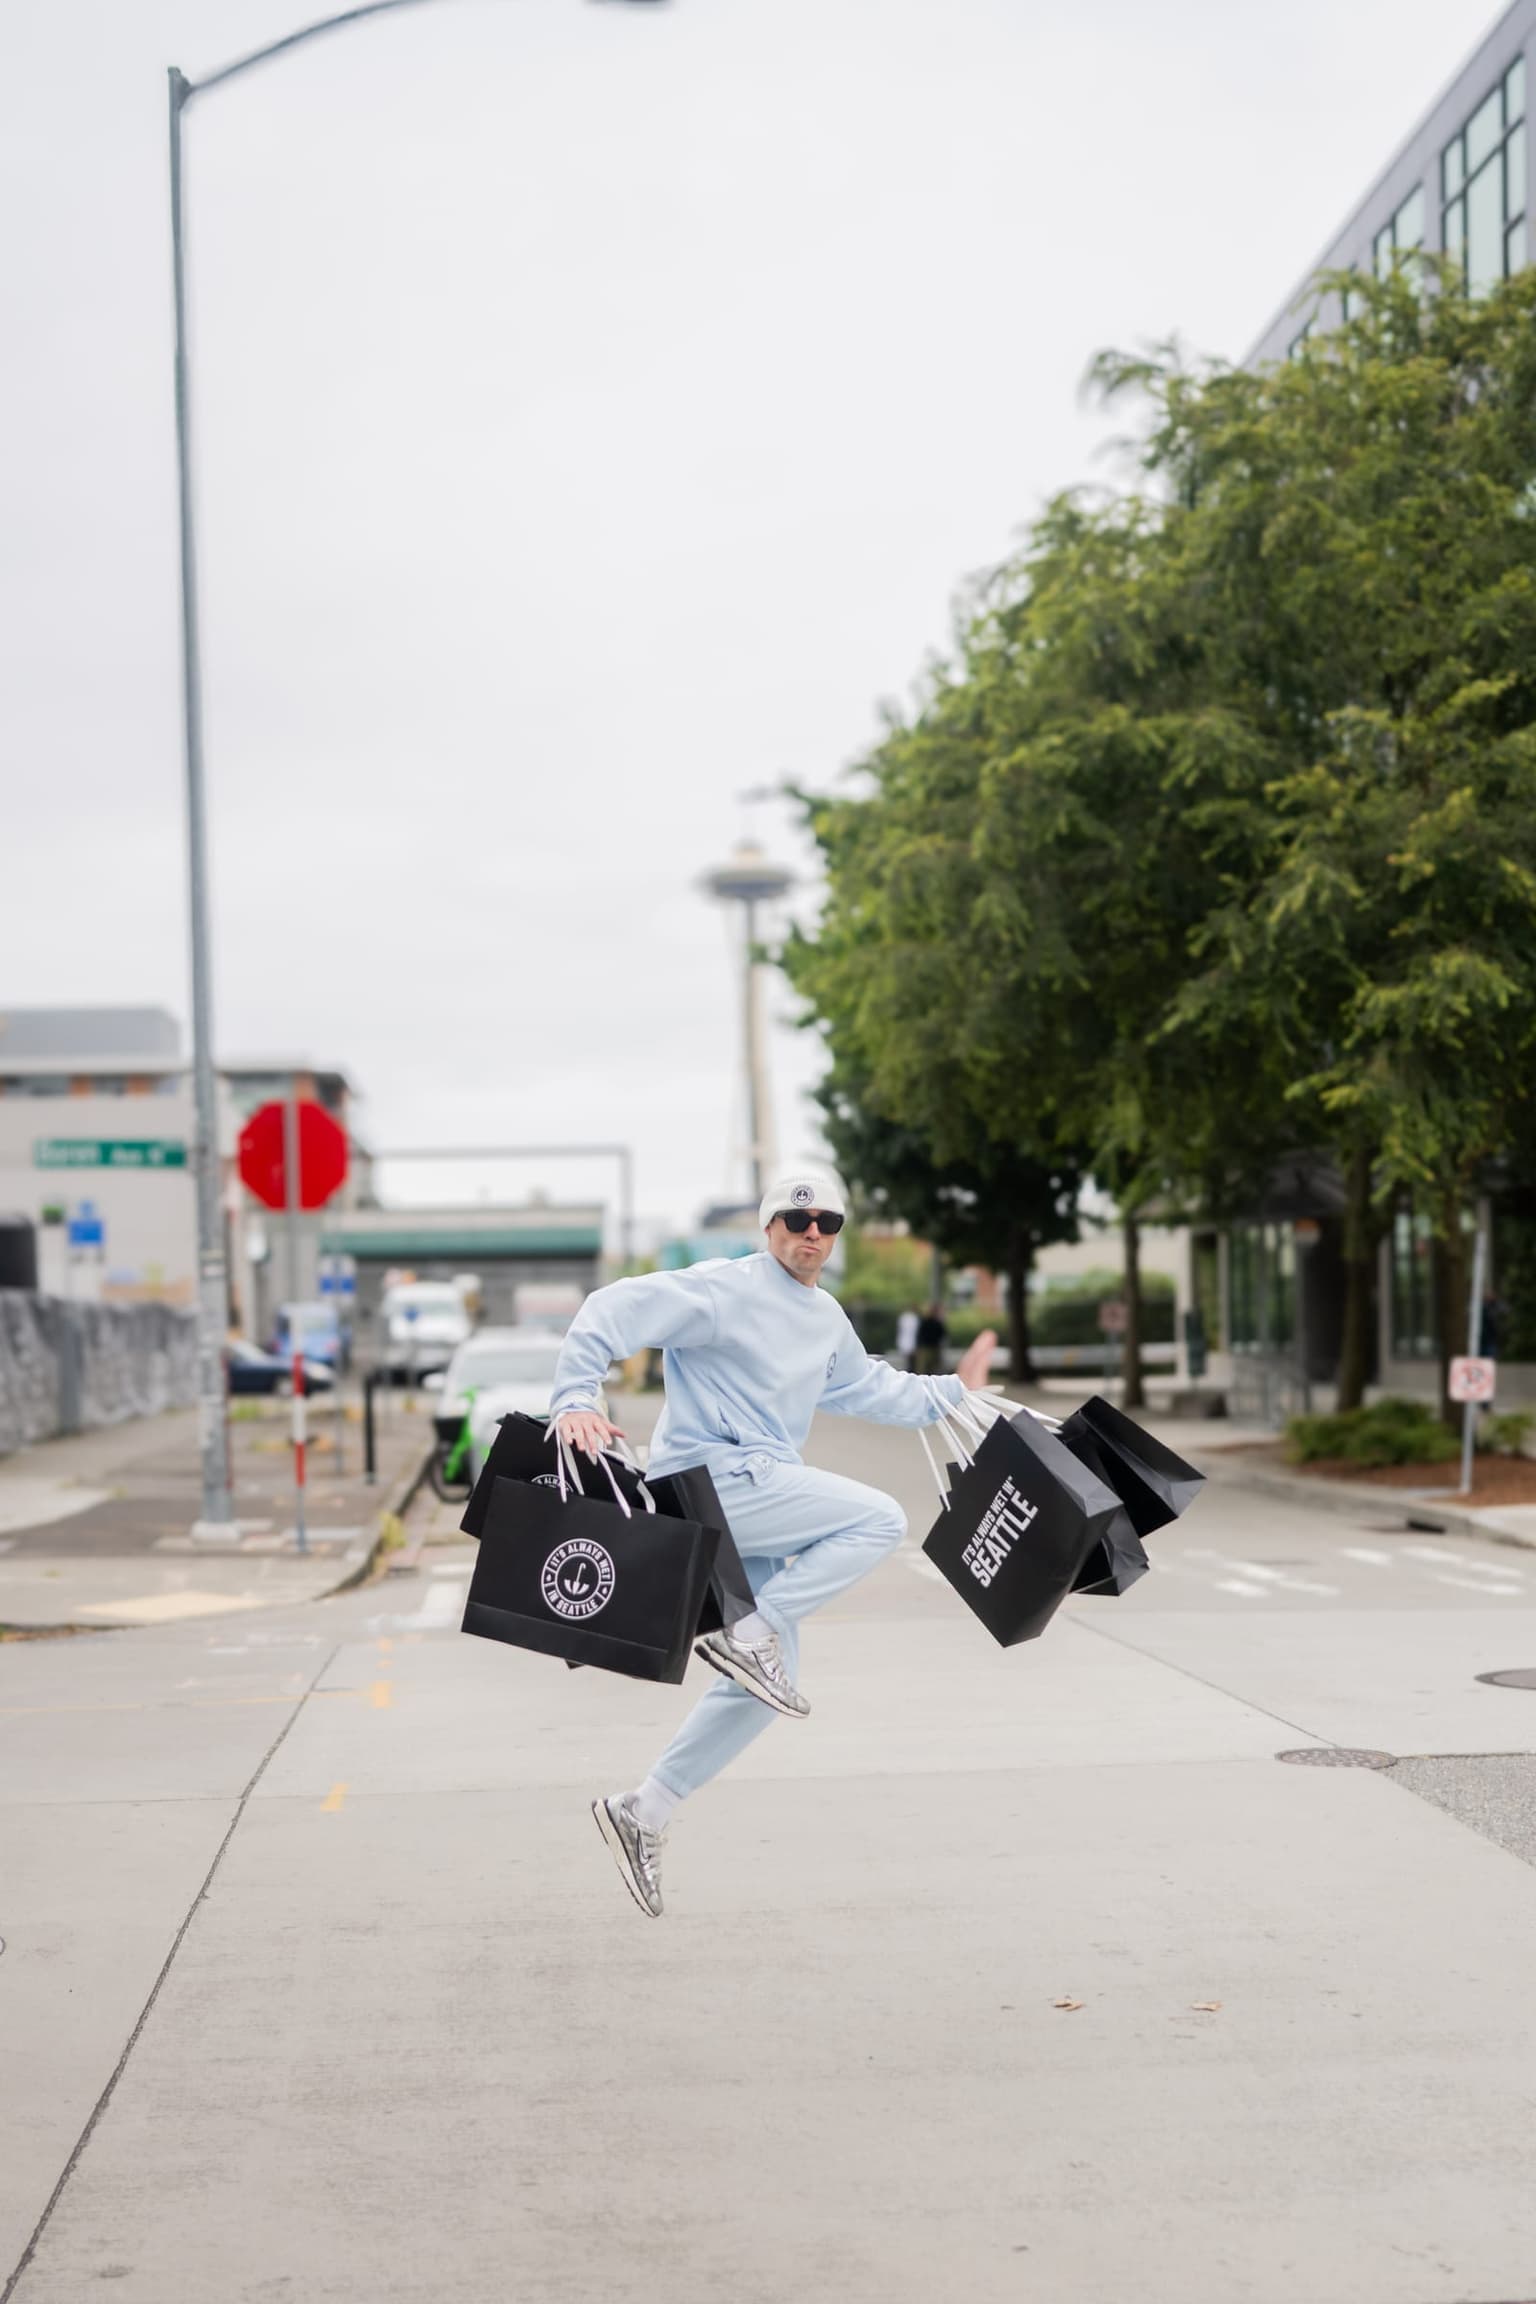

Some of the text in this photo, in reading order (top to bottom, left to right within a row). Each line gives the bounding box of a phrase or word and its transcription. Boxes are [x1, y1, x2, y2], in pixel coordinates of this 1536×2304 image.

[961, 1544, 977, 1566] IT'S
[972, 1510, 996, 1550] ALWAYS
[990, 1490, 1009, 1515] WET
[970, 1490, 1039, 1588] SEATTLE
[549, 1542, 611, 1580] IT'S ALWAYS WET
[547, 1590, 599, 1616] IN SEATTLE
